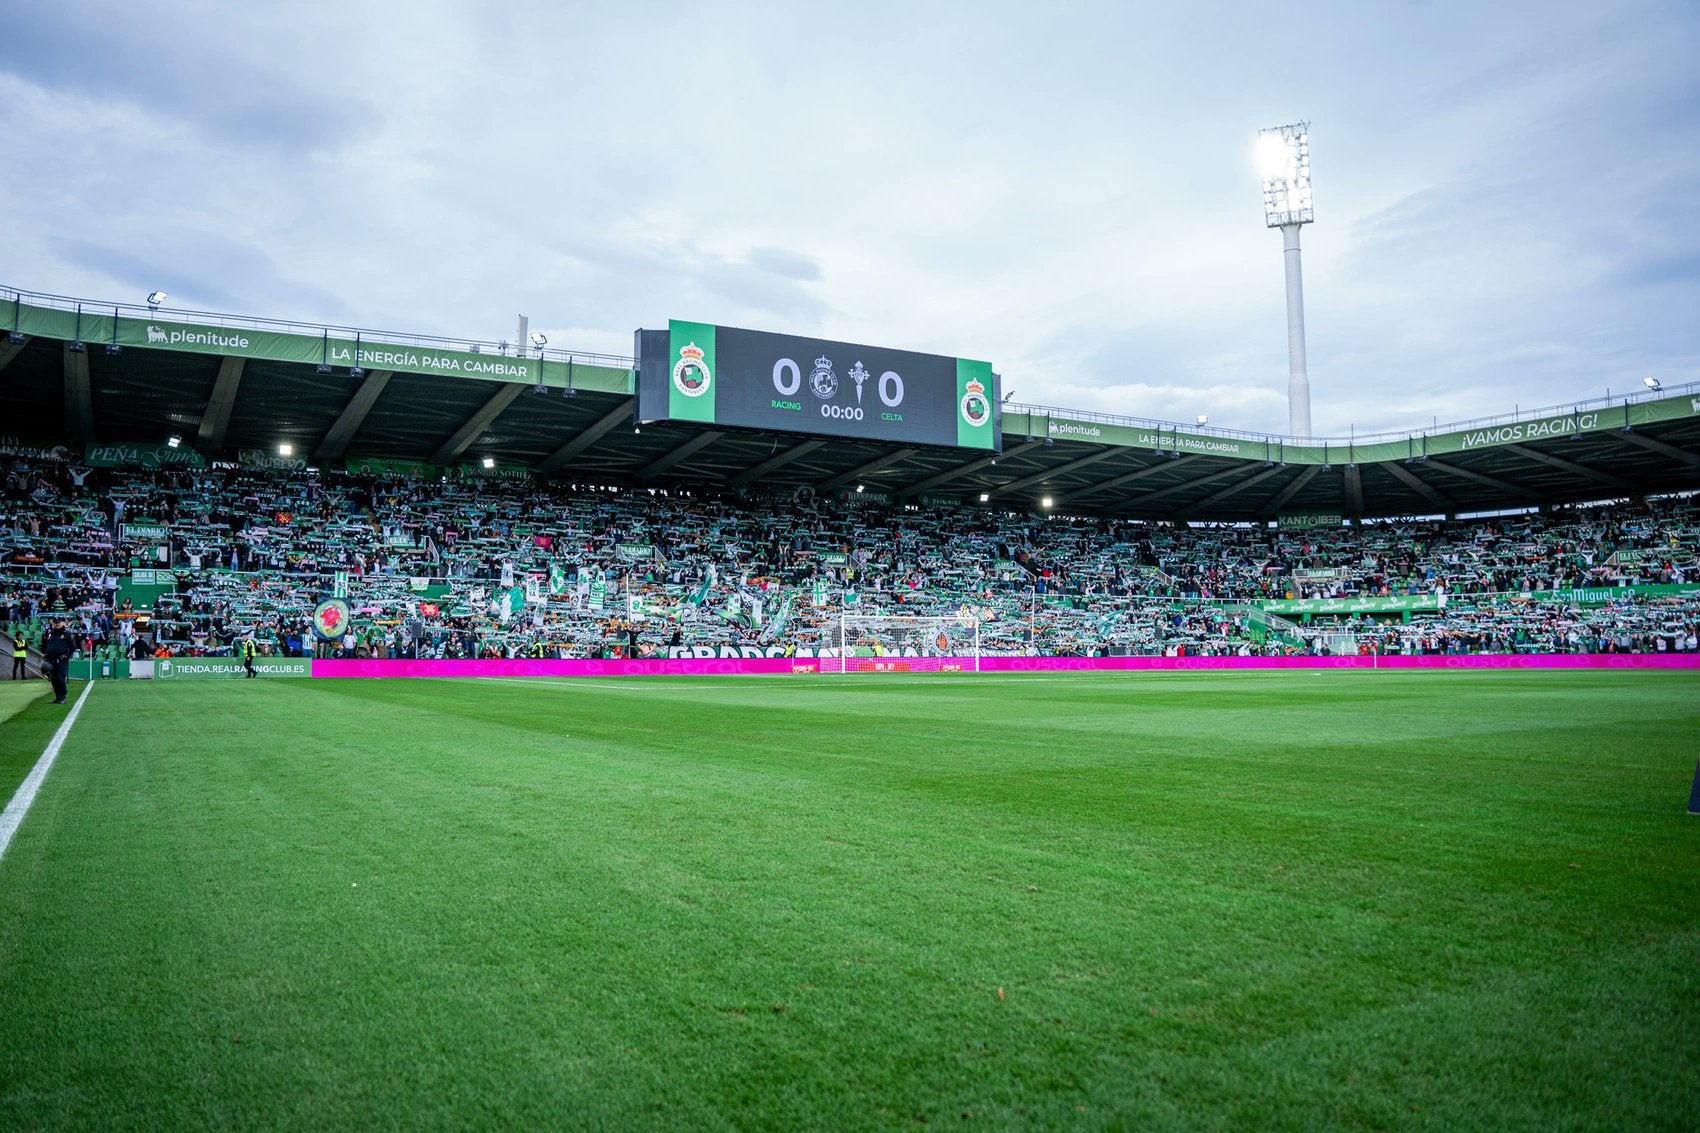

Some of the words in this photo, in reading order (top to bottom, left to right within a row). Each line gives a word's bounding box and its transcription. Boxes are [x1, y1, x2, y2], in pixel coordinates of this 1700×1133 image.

[170, 330, 249, 348] plenitude
[332, 347, 350, 360] LA
[355, 349, 418, 367] ENERGÍA
[422, 356, 460, 370] PARA
[463, 361, 527, 377] CAMBIAR
[772, 357, 801, 396] 0
[878, 371, 904, 407] 0
[771, 399, 801, 411] RACING
[821, 404, 864, 421] 00:00
[881, 412, 903, 422] CELTA
[1059, 424, 1101, 437] plenitude
[1462, 426, 1522, 450] ¡VAMOS
[1526, 413, 1598, 438] RACING!
[1139, 434, 1149, 443] LA
[1151, 435, 1185, 448] ENERGÍA
[1185, 440, 1206, 450] PARA
[1206, 441, 1239, 453] CAMBIAR
[89, 445, 138, 462] PEÑA
[137, 526, 165, 534] DIARIO
[176, 664, 305, 674] TIENDA.REALRAINGCLUB.ES
